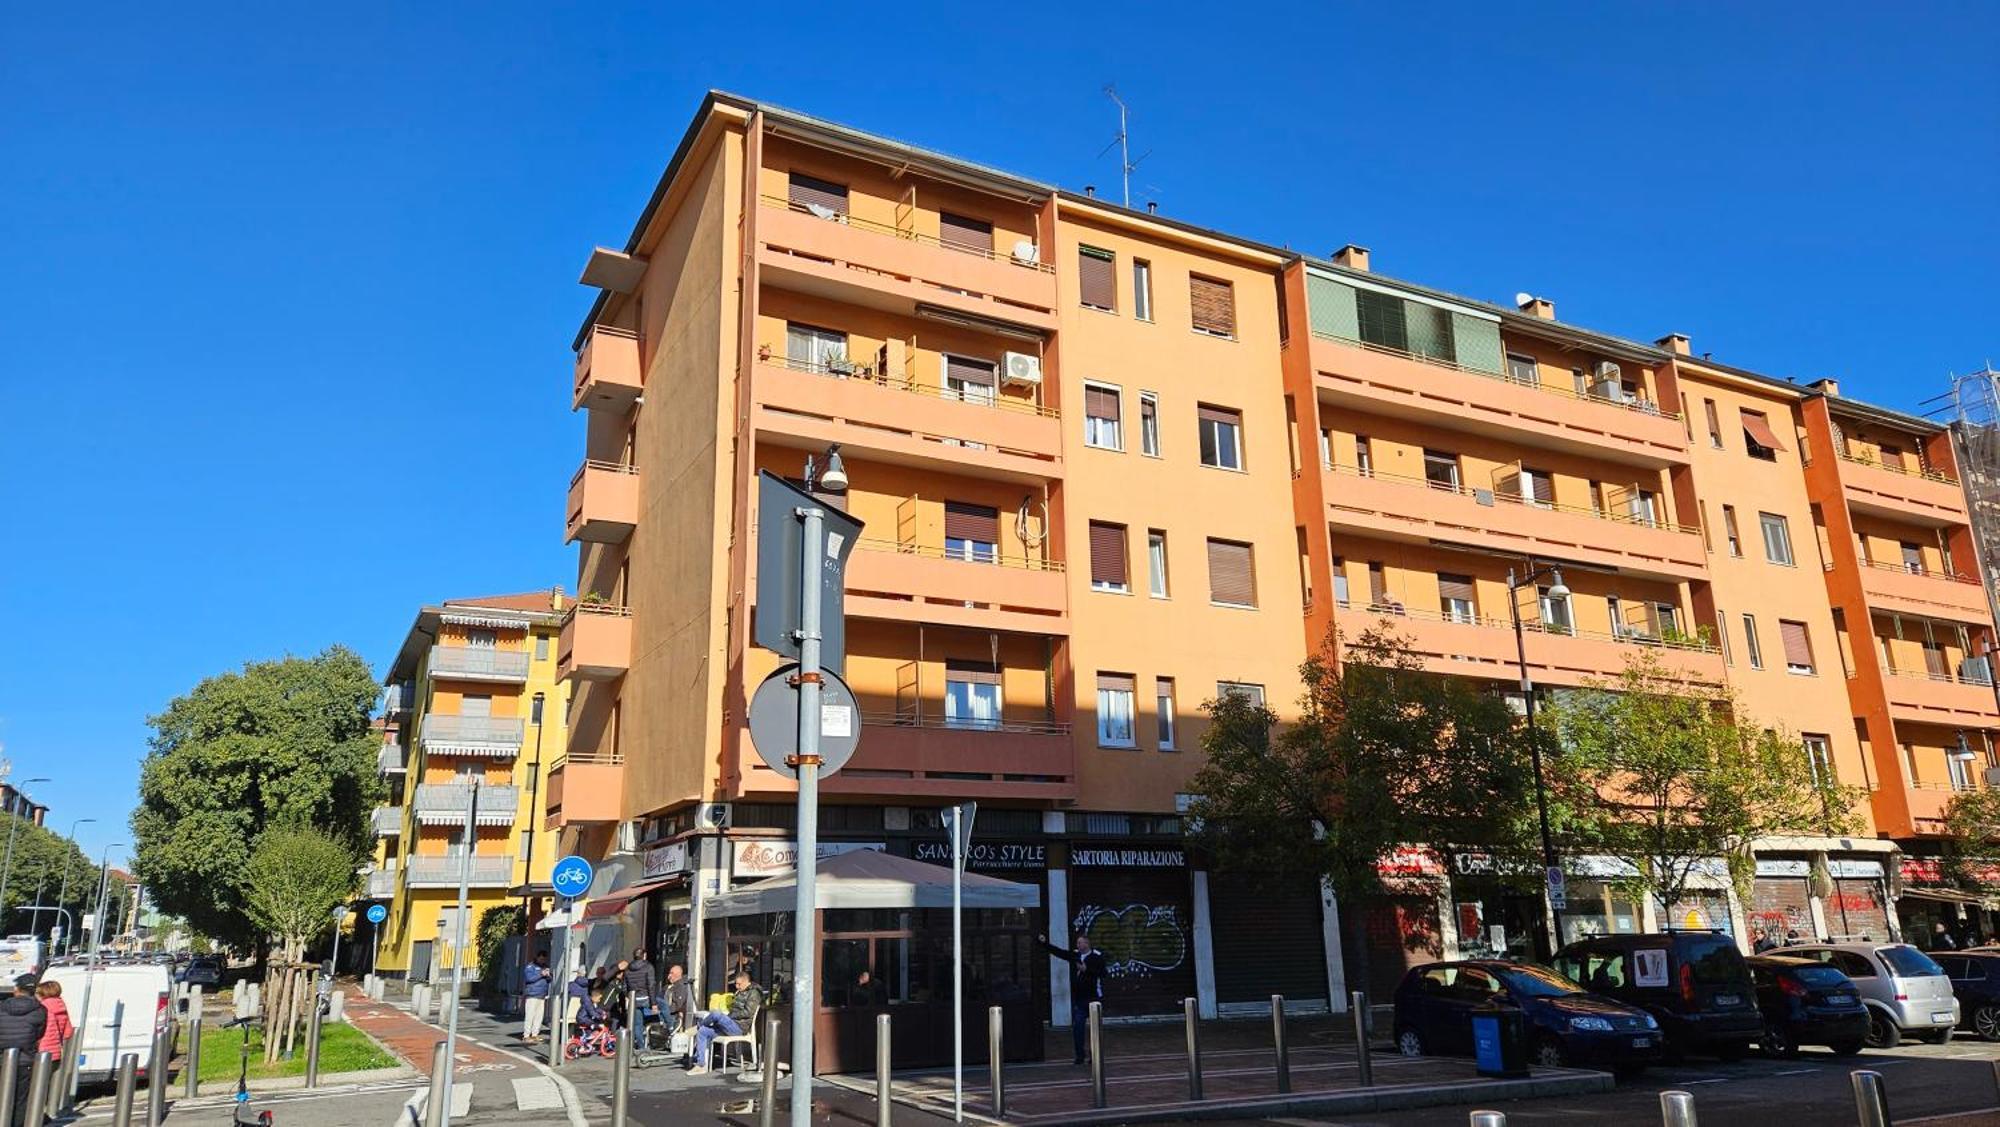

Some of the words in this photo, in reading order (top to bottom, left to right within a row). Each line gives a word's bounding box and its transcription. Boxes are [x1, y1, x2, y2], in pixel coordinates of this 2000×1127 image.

[915, 843, 995, 860] SANRO's
[1000, 844, 1045, 861] STYLE
[1071, 850, 1120, 865] SARTORIA
[1121, 850, 1185, 866] RIPARAZIONE
